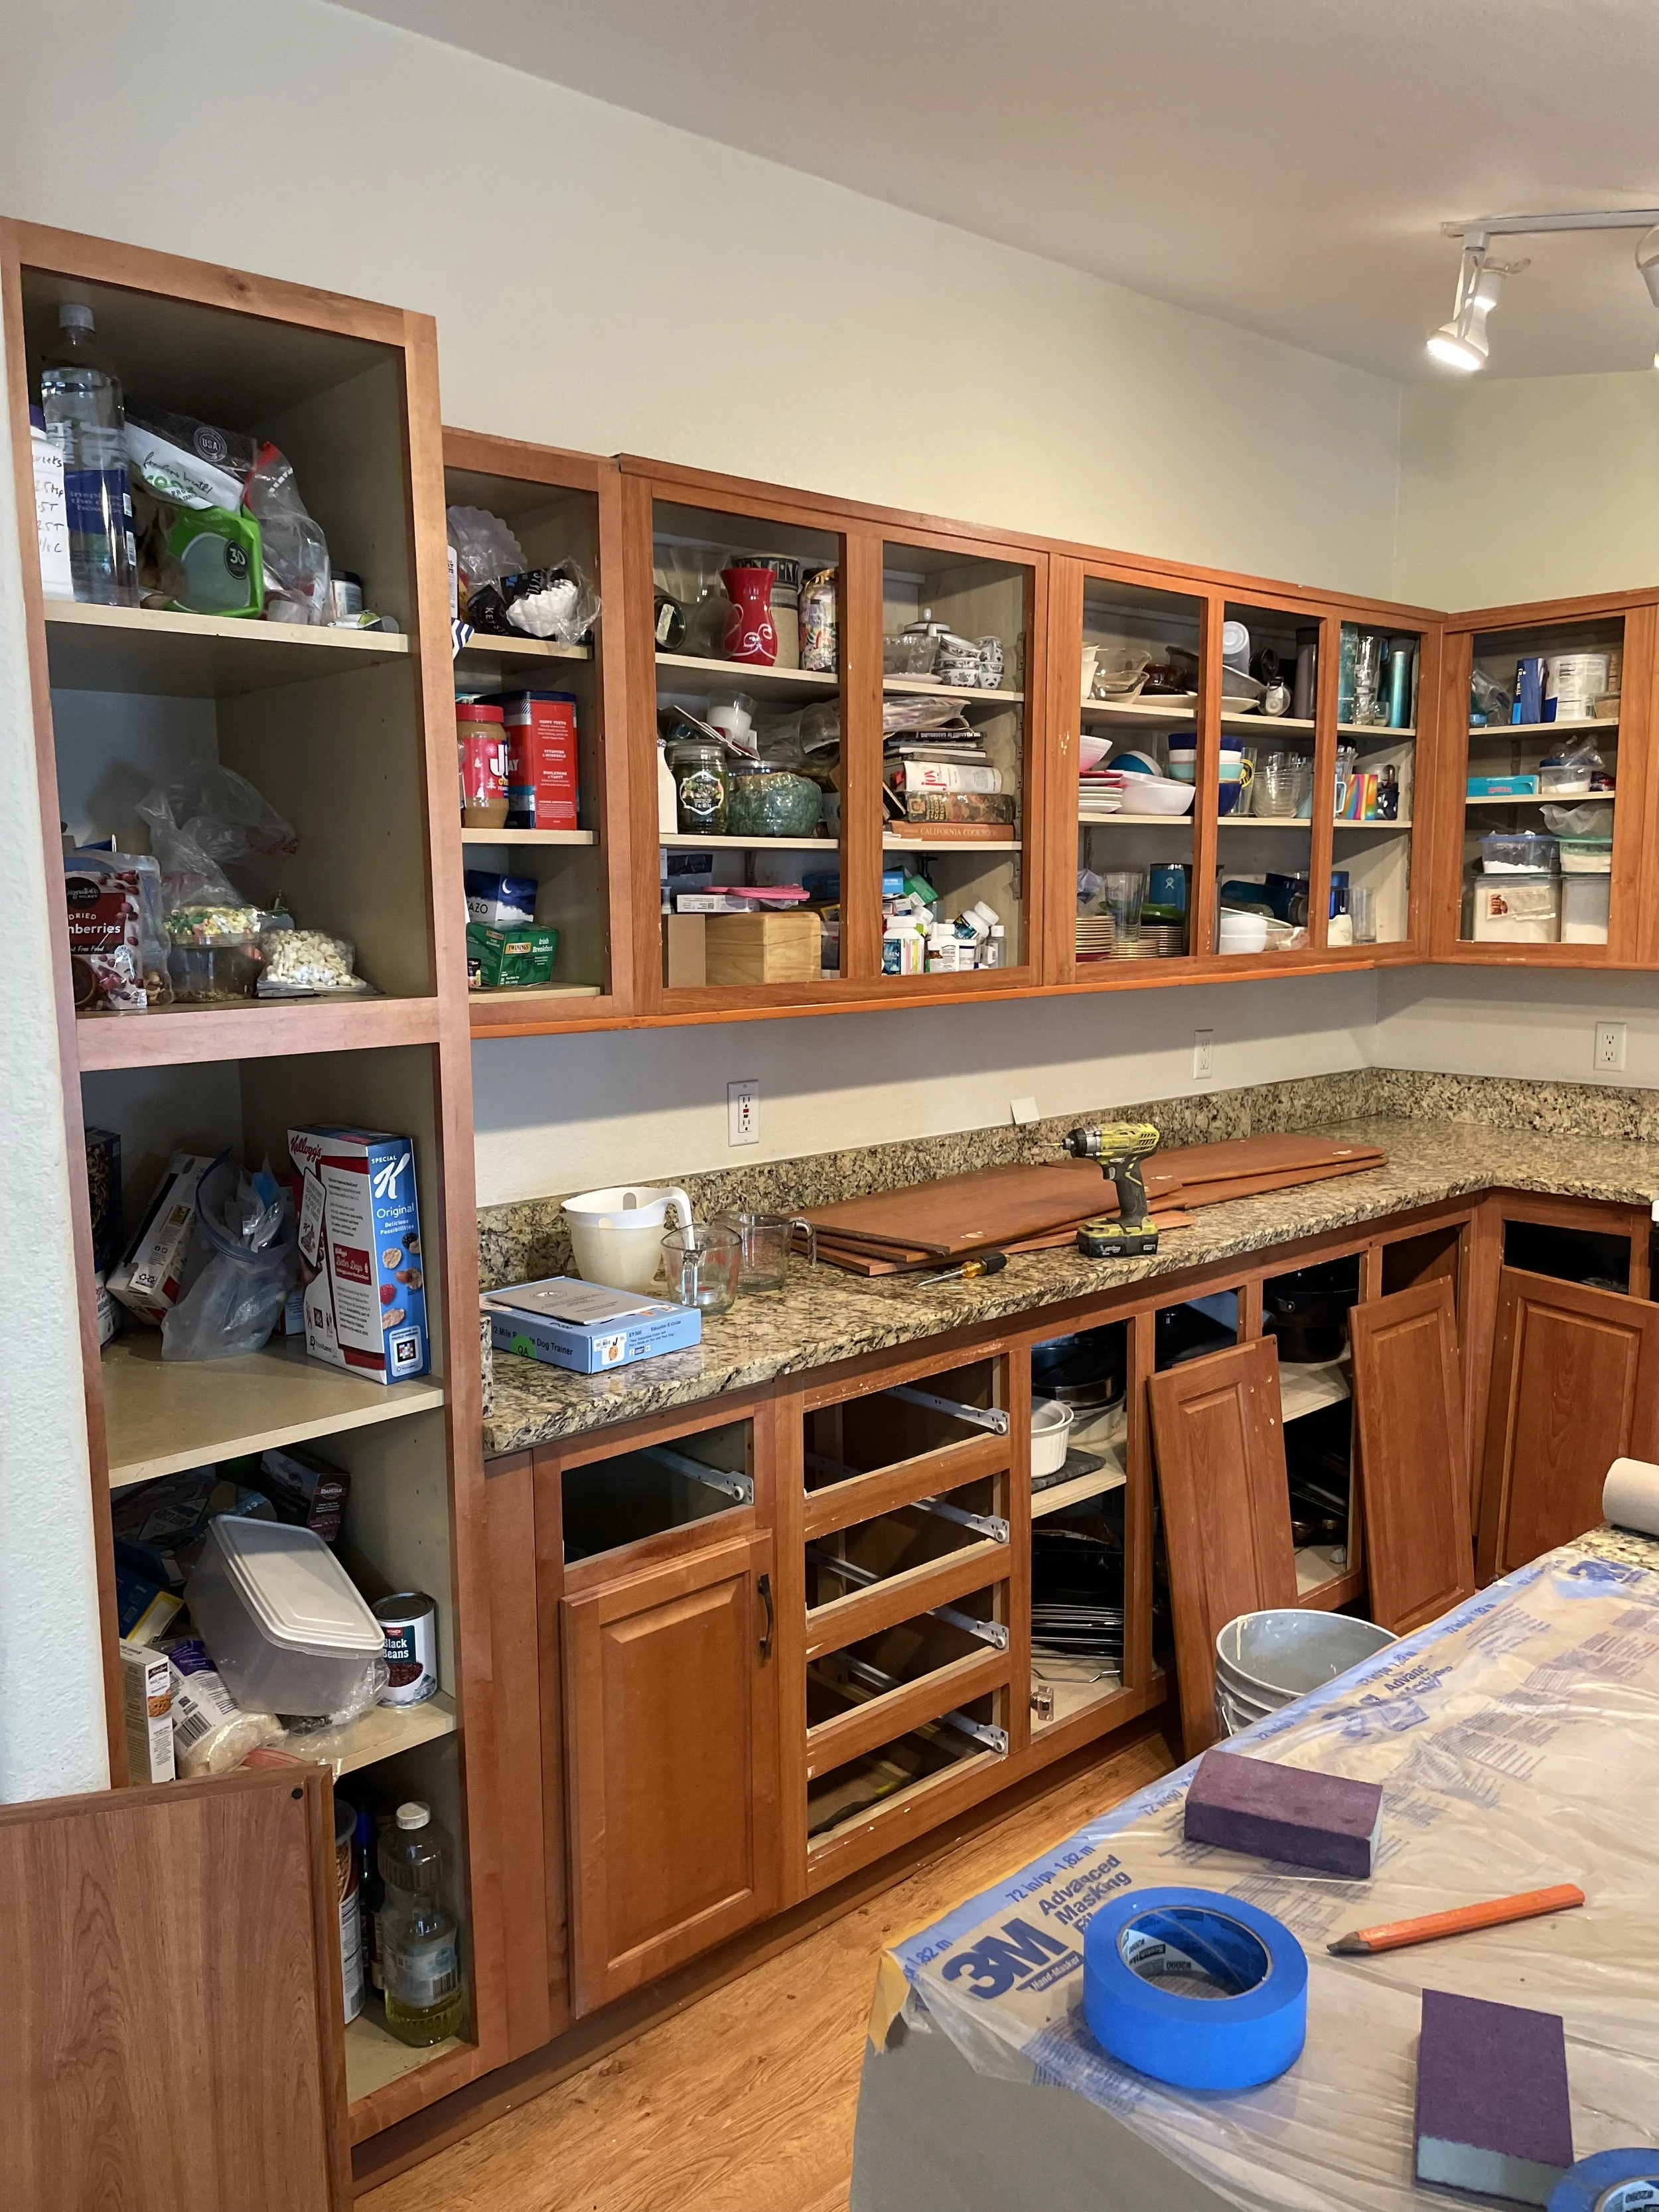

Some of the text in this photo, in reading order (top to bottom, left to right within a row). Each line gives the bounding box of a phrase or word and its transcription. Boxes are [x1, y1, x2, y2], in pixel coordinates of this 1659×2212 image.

[202, 438, 219, 451] USA
[229, 548, 246, 565] 30
[489, 744, 509, 777] Ji
[920, 770, 948, 792] joy
[920, 828, 962, 836] CALIFORNIA
[467, 901, 488, 915] AZO
[68, 922, 121, 934] nberries
[290, 1134, 323, 1163] Kellogg's
[371, 1155, 397, 1164] SPECIAL
[373, 1153, 411, 1199] K
[376, 1203, 415, 1219] Original
[380, 1224, 415, 1235] Possibilities
[384, 1218, 409, 1228] Delicious
[499, 1327, 512, 1338] Mile
[536, 1338, 550, 1351] Dog
[550, 1342, 573, 1356] Trainer
[517, 1345, 529, 1357] QA
[1005, 1887, 1029, 1903] 72
[1054, 1850, 1082, 1871] 1,82
[1080, 1844, 1097, 1858] m
[1038, 1853, 1121, 1917] Advanced
[1053, 1870, 1133, 1926] Masking
[941, 1917, 1070, 2000] 3M
[1165, 1960, 1192, 1971] #2090
[1030, 1954, 1081, 1992] Hand-Masker
